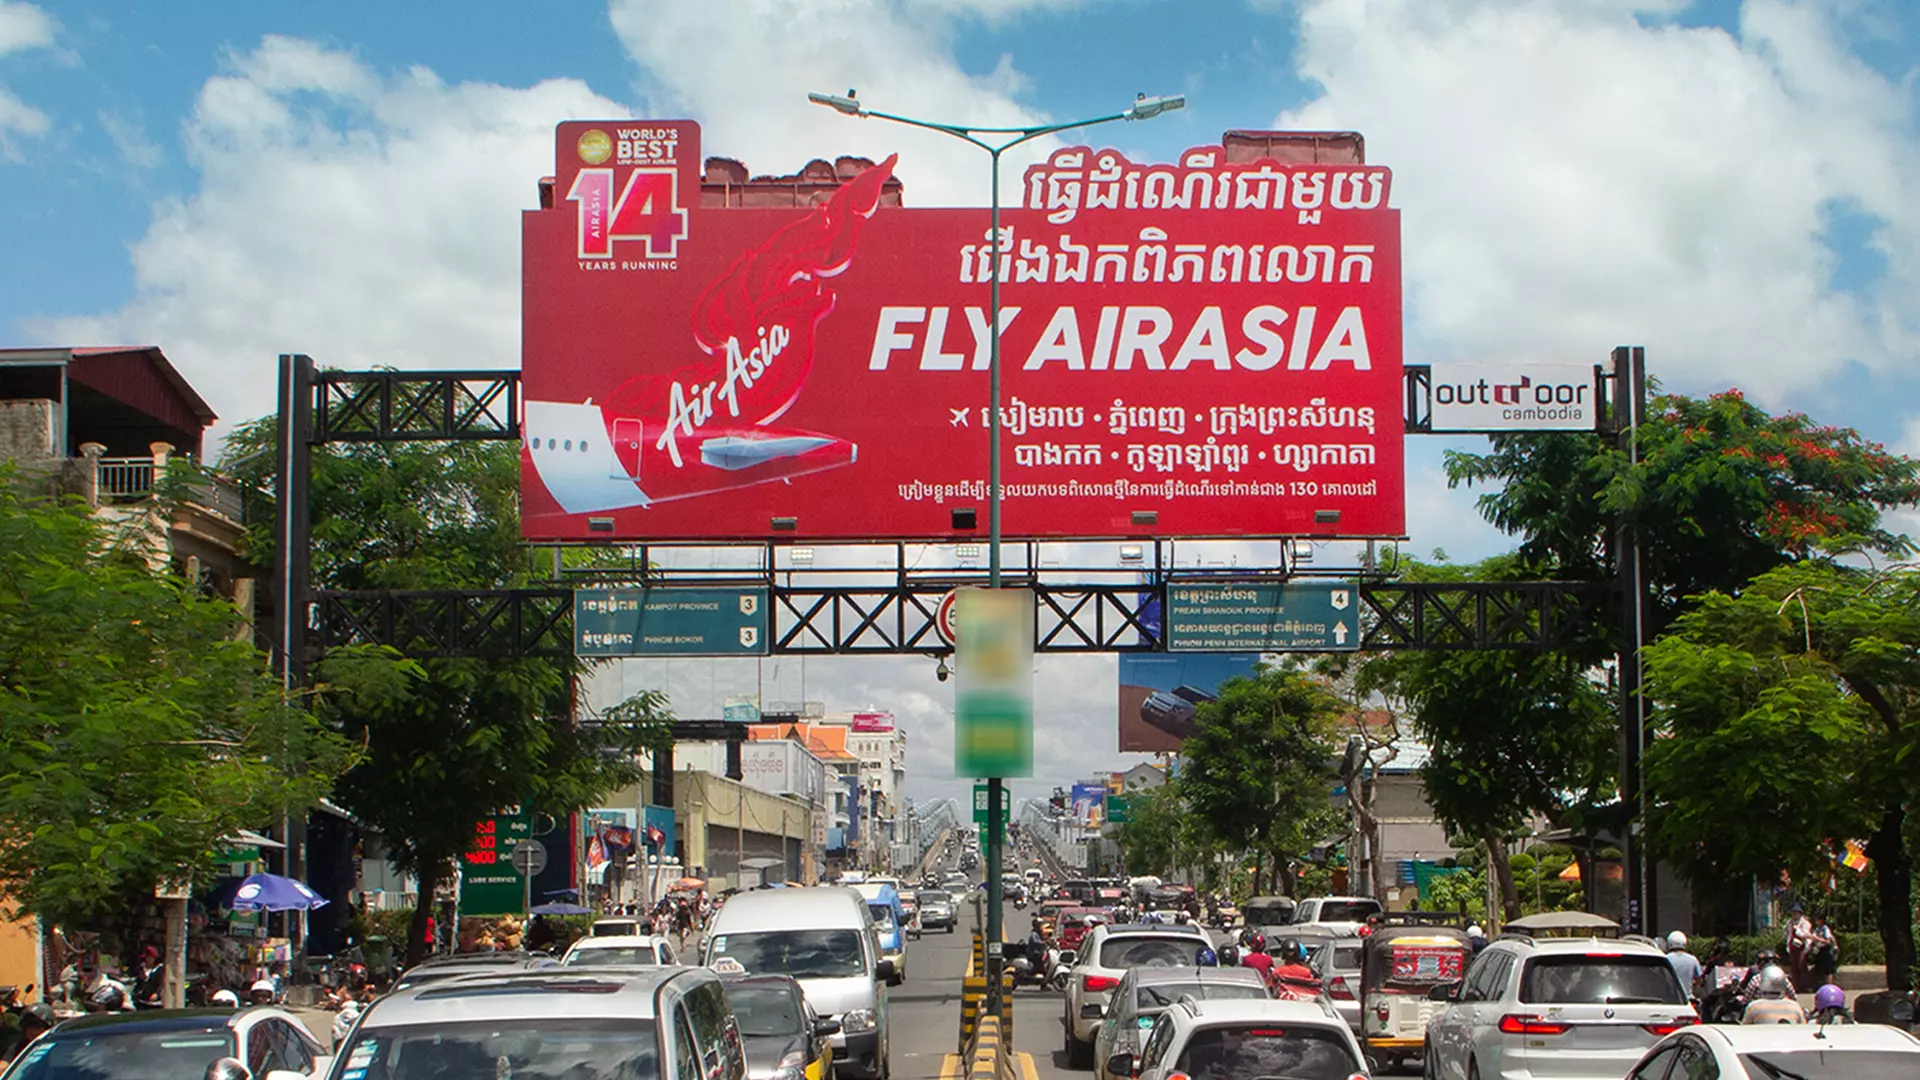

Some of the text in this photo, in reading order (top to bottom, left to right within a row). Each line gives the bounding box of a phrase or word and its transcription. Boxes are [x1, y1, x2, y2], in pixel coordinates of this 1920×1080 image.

[616, 140, 678, 159] BEST
[565, 168, 688, 259] 14
[591, 188, 601, 238] AIRASIA
[578, 261, 678, 270] YEARS RUNNING
[868, 305, 1371, 371] FLY AIRASIA
[1108, 397, 1187, 436] ភ្នំពេញ
[1502, 406, 1583, 420] cambodia
[1014, 441, 1102, 467] បាងកក
[1288, 481, 1319, 497] 130
[644, 601, 720, 612] KAMPOT PROVINCE
[743, 598, 753, 612] 3
[1335, 593, 1345, 605] 4
[743, 629, 753, 643] 3
